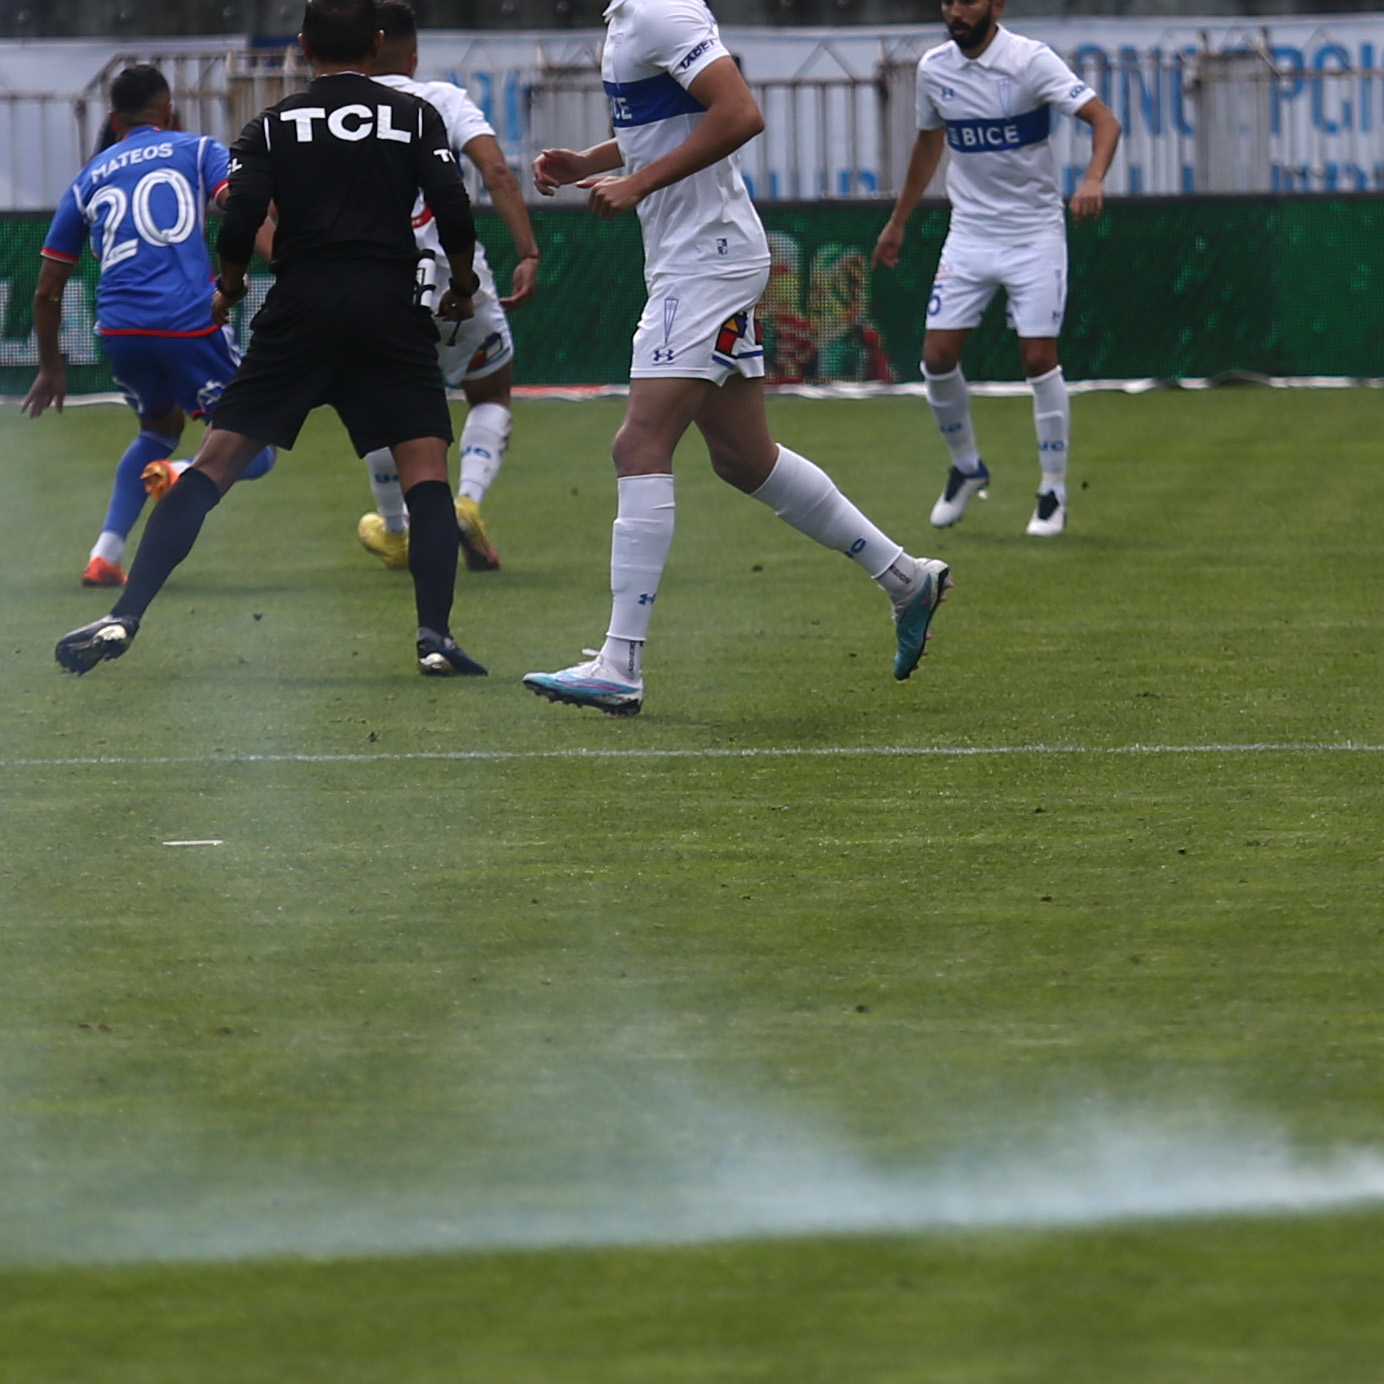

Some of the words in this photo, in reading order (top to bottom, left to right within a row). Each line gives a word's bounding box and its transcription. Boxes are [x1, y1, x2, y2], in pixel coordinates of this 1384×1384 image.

[280, 104, 412, 143] TCL
[962, 124, 1020, 148] BICE
[90, 141, 174, 185] MATEOS
[88, 167, 197, 274] 20
